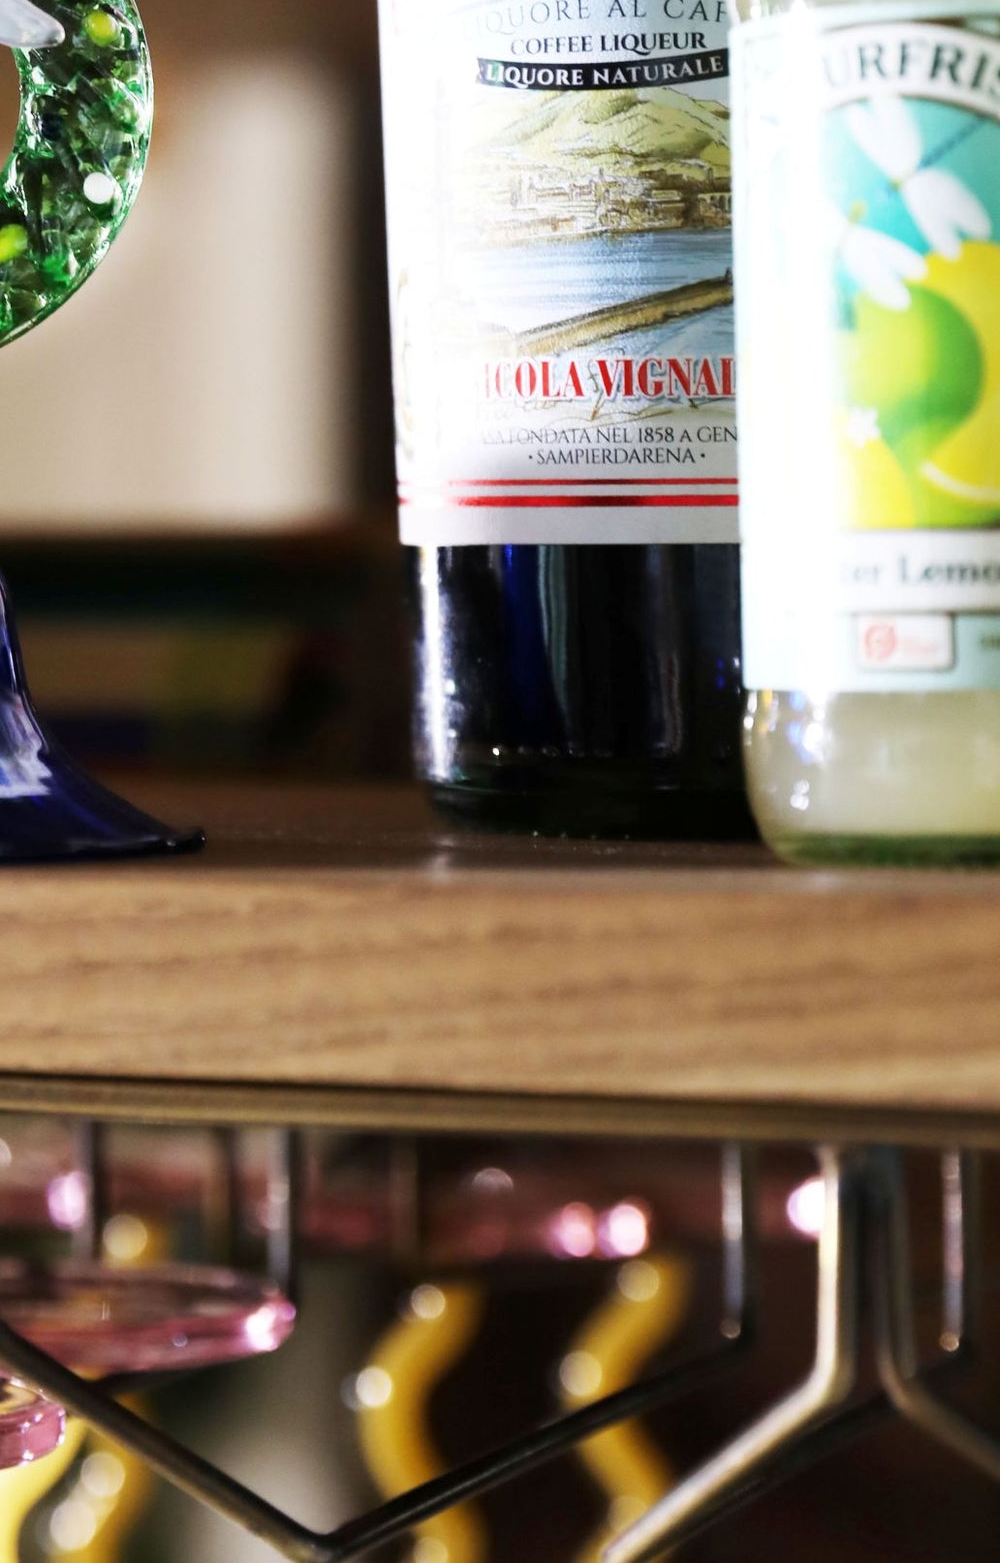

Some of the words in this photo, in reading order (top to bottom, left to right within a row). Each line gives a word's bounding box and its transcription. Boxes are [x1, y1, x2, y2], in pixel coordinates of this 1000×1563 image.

[511, 35, 593, 55] COFFEE
[601, 32, 707, 56] LIQUEUR
[486, 62, 584, 88] LIQUORE
[593, 55, 724, 86] NATURALE
[822, 40, 1000, 97] URFRI
[597, 427, 632, 443] NEL
[638, 427, 674, 442] 1858
[679, 428, 692, 442] A
[537, 447, 695, 465] SAMPIERDARENA
